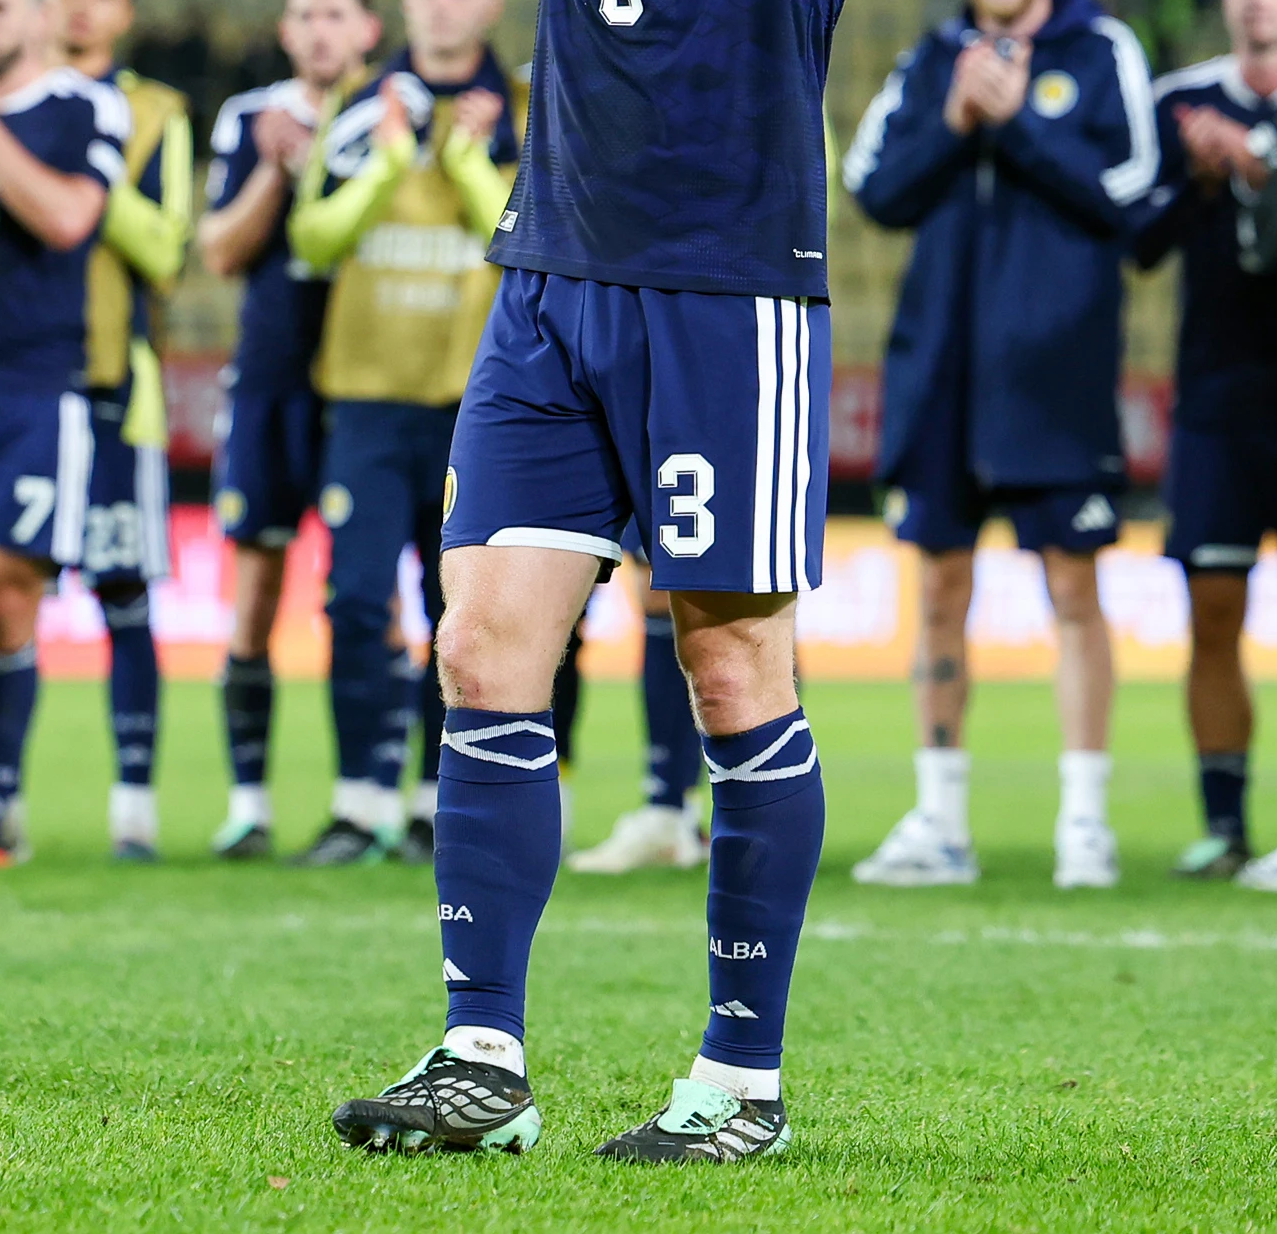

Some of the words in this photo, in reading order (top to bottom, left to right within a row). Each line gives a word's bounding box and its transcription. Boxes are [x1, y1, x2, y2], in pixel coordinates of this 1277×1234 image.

[11, 474, 57, 546] 7
[657, 453, 715, 558] 3
[709, 936, 768, 959] ALBA
